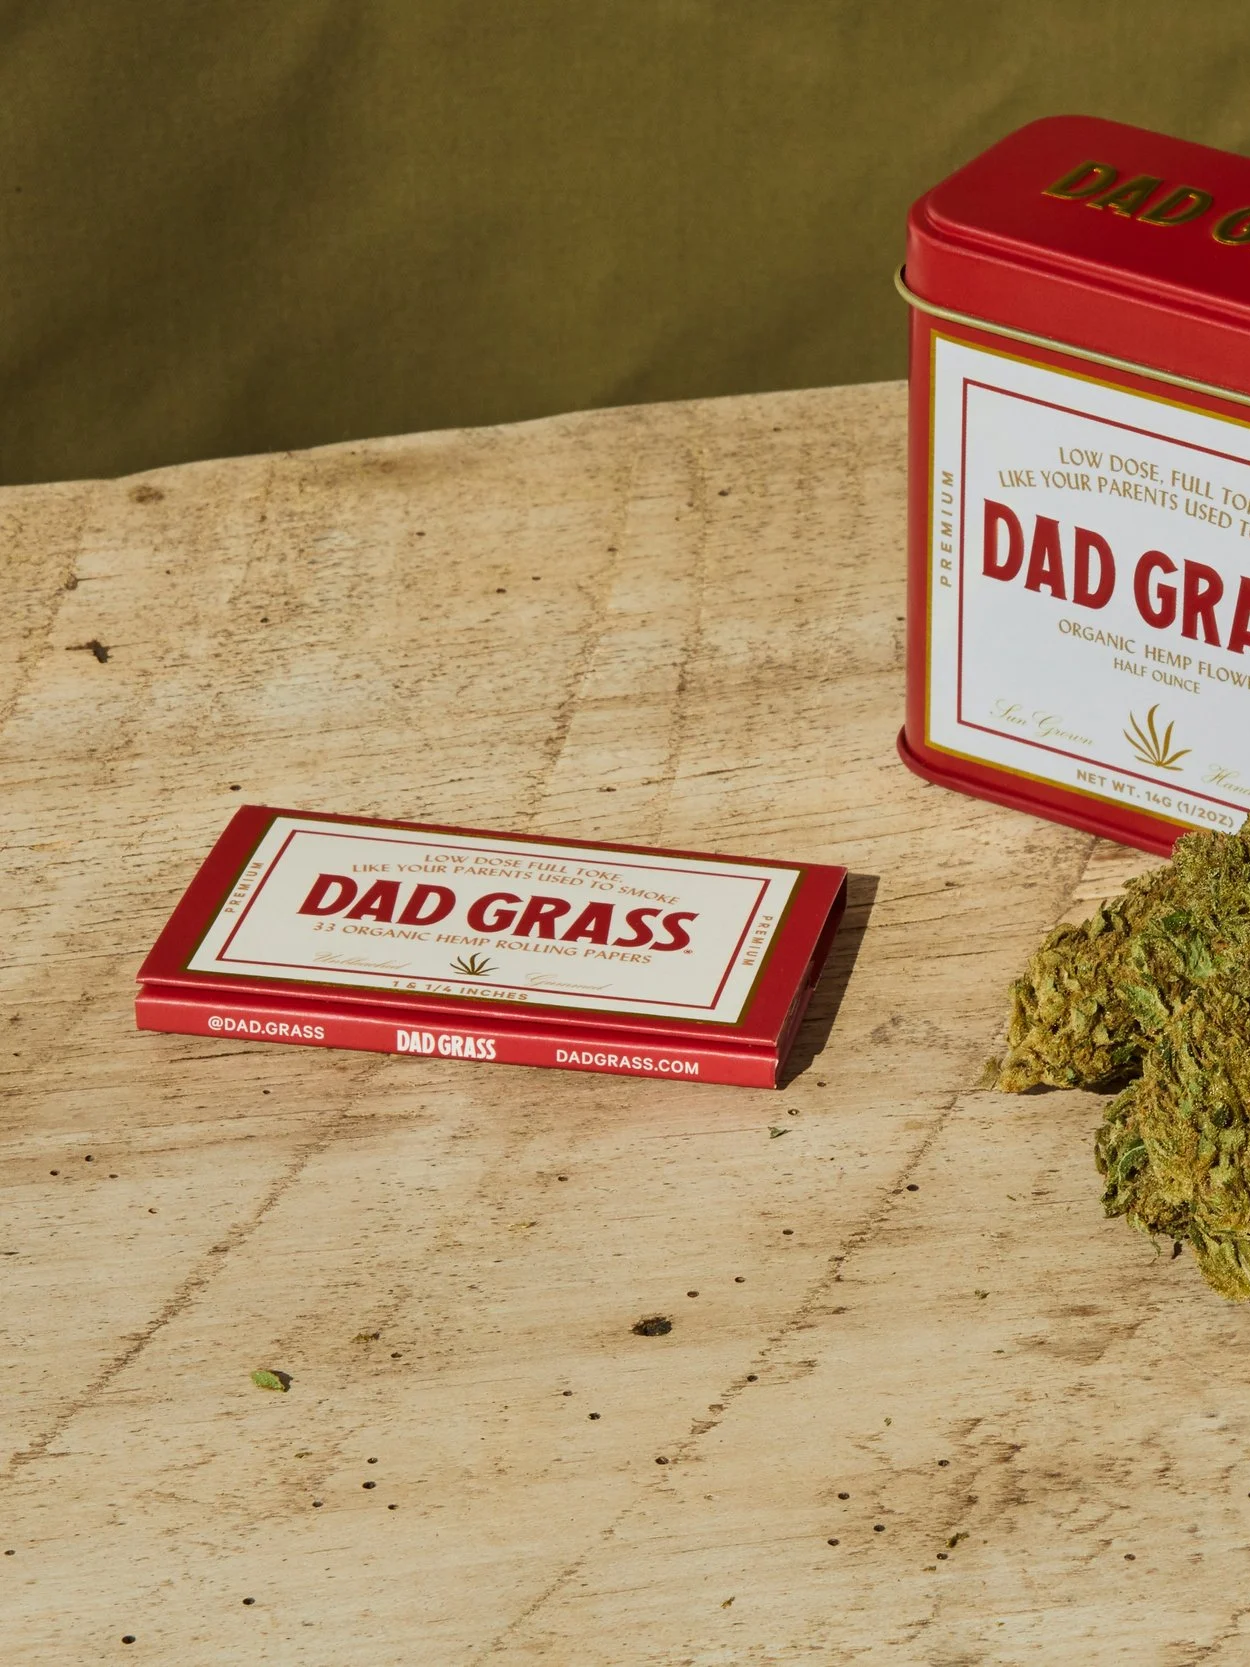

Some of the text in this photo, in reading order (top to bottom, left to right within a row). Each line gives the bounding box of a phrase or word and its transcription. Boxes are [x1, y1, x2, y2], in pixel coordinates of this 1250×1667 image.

[1041, 159, 1213, 227] DAD
[1059, 447, 1102, 468] LOW
[1110, 454, 1163, 484] DOSE,
[1171, 470, 1214, 500] FULL
[998, 470, 1037, 488] LIKE
[1040, 470, 1092, 492] YOUR
[1098, 476, 1178, 511] PARENTS
[1184, 498, 1233, 529] USED
[940, 470, 954, 588] PREMIUM
[982, 498, 1117, 610] DAD
[1058, 619, 1136, 654] ORGANIC
[1144, 644, 1193, 670] HEMP
[1113, 657, 1201, 695] HALF OUNCE
[989, 698, 1094, 746] Sun Grown
[1076, 768, 1235, 829] NET WT. 14G (1/2OZ)
[224, 862, 264, 913] PREMIUM
[352, 864, 681, 905] LIKE YOUR PARENTS USED TO SMOKE
[424, 854, 469, 864] LOW
[474, 856, 523, 869] DOSE
[528, 861, 567, 874] FULL
[296, 873, 456, 926] DAD
[313, 921, 653, 964] 33 ORGANIC HEMP ROLLING PAPERS
[742, 915, 773, 966] PREMIUM
[425, 984, 452, 992] 1/4
[459, 987, 529, 1001] INCHES
[207, 1015, 325, 1040] @DAD.GRASS
[396, 1029, 497, 1060] DAD GRASS
[556, 1049, 699, 1075] DADGRASS.COM
